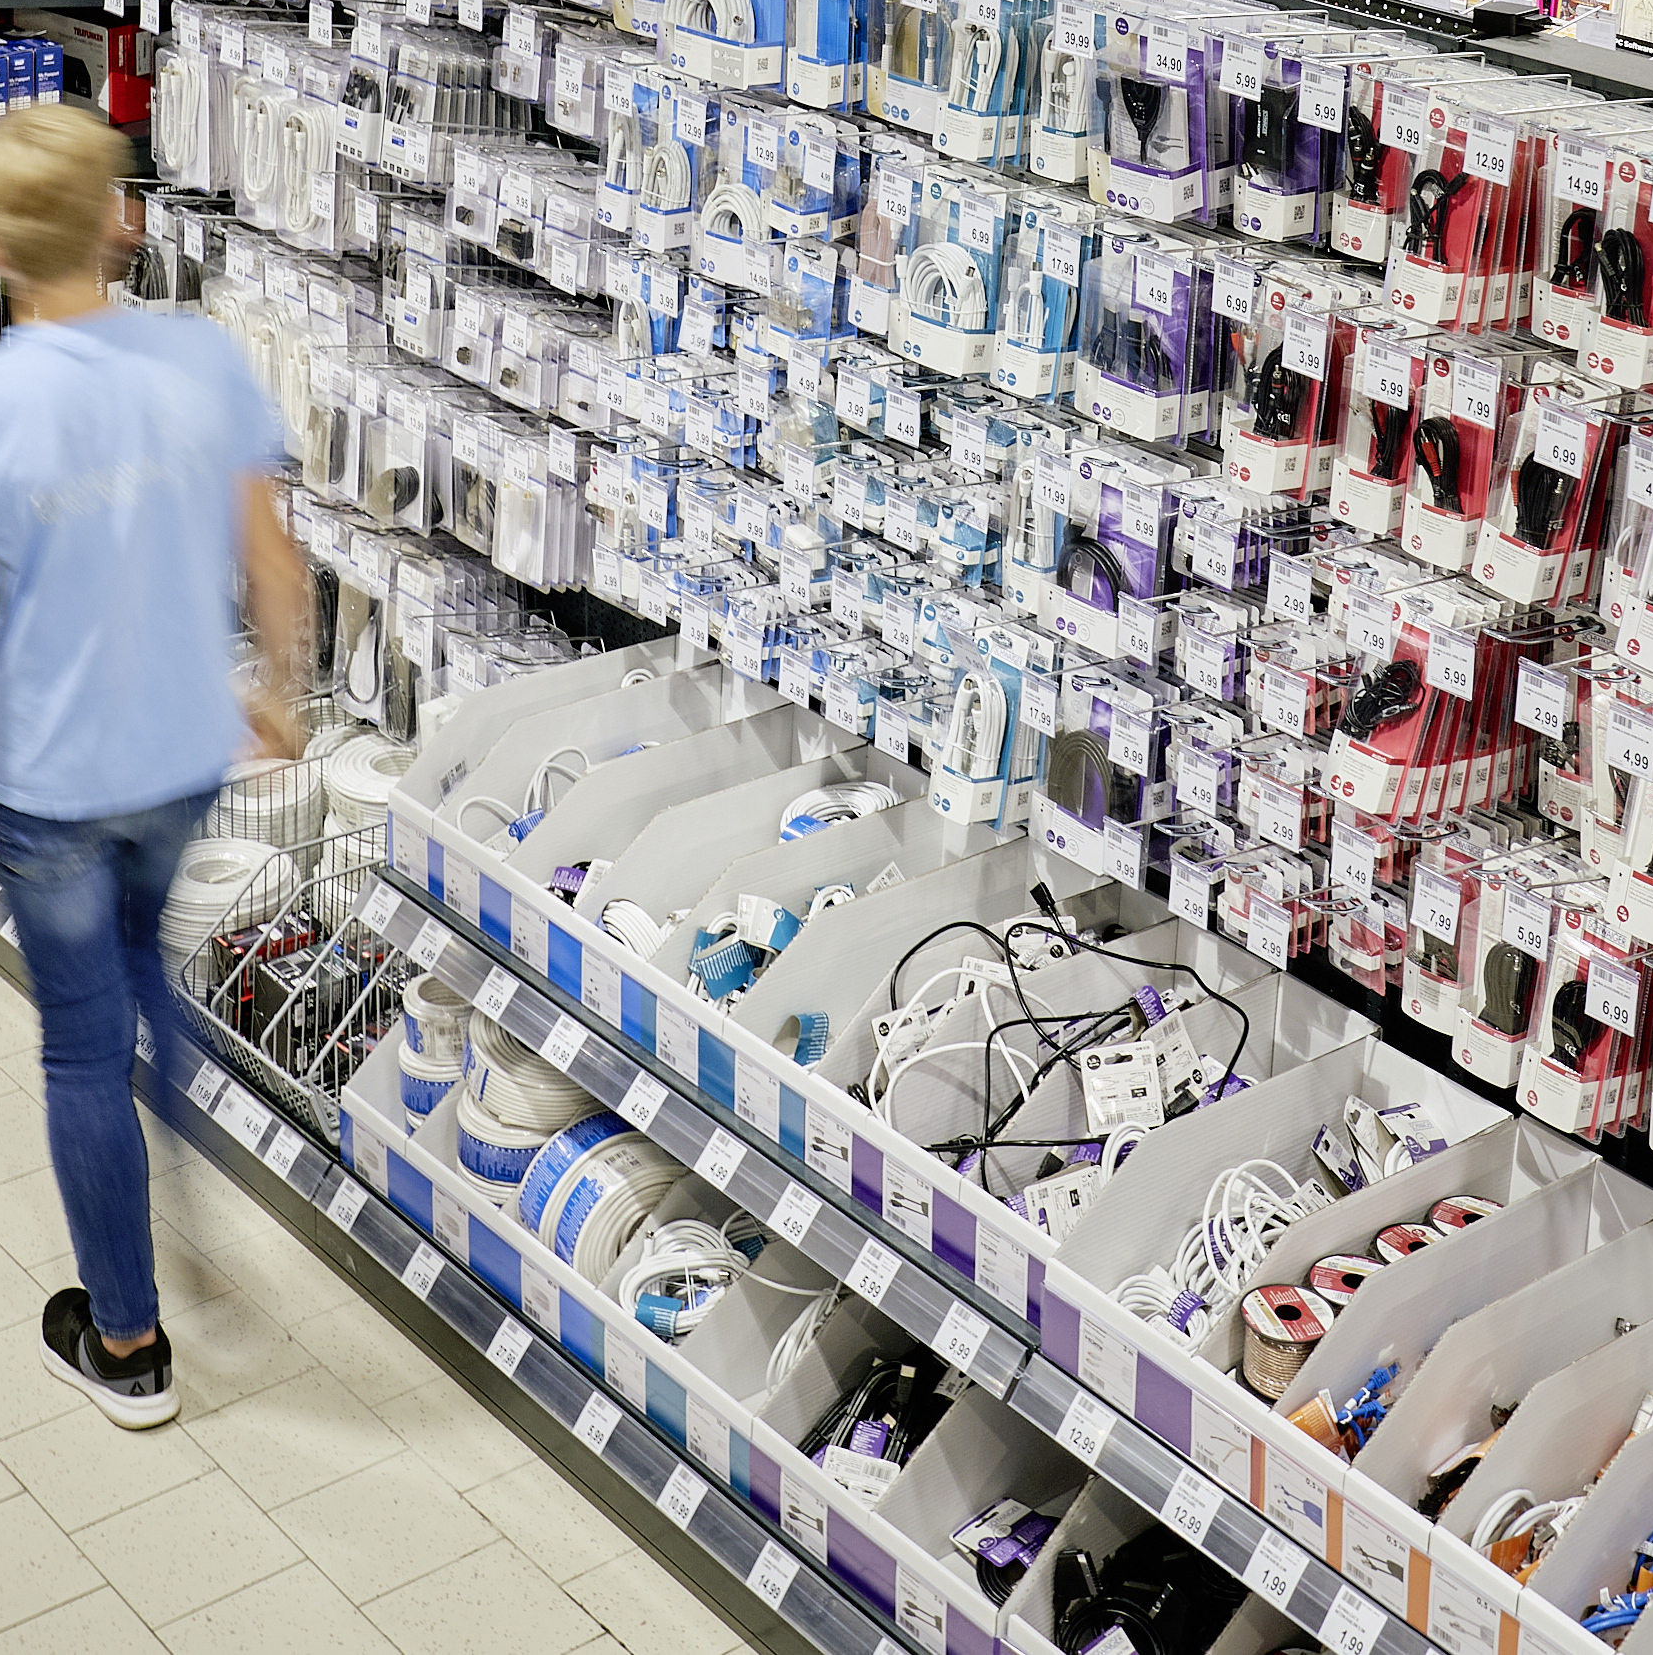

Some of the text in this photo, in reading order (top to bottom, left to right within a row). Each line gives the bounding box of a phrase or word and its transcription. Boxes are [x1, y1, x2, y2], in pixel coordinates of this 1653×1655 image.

[1064, 31, 1090, 49] 39,99
[1156, 54, 1182, 72] 34,90
[1235, 72, 1256, 90] 5,99
[611, 93, 630, 109] 11,99
[1314, 103, 1336, 121] 5,99
[1396, 125, 1420, 145] 9,99
[1476, 151, 1505, 173] 12,99
[1567, 175, 1599, 196] 14,99
[1051, 257, 1074, 276] 17,99
[1380, 378, 1403, 398] 5,99
[1467, 396, 1490, 419] 7,99
[1467, 396, 1490, 419] 7,99
[1552, 445, 1576, 466] 6,99
[1042, 485, 1065, 505] 11,99
[1363, 629, 1385, 650] 7,99
[1443, 666, 1467, 687] 5,99
[1277, 707, 1299, 727] 3,99
[1534, 707, 1558, 728] 2,99
[1623, 748, 1649, 770] 4,99
[1430, 908, 1452, 931] 7,99
[1517, 926, 1542, 949] 5,99
[1602, 1000, 1629, 1024] 6,99
